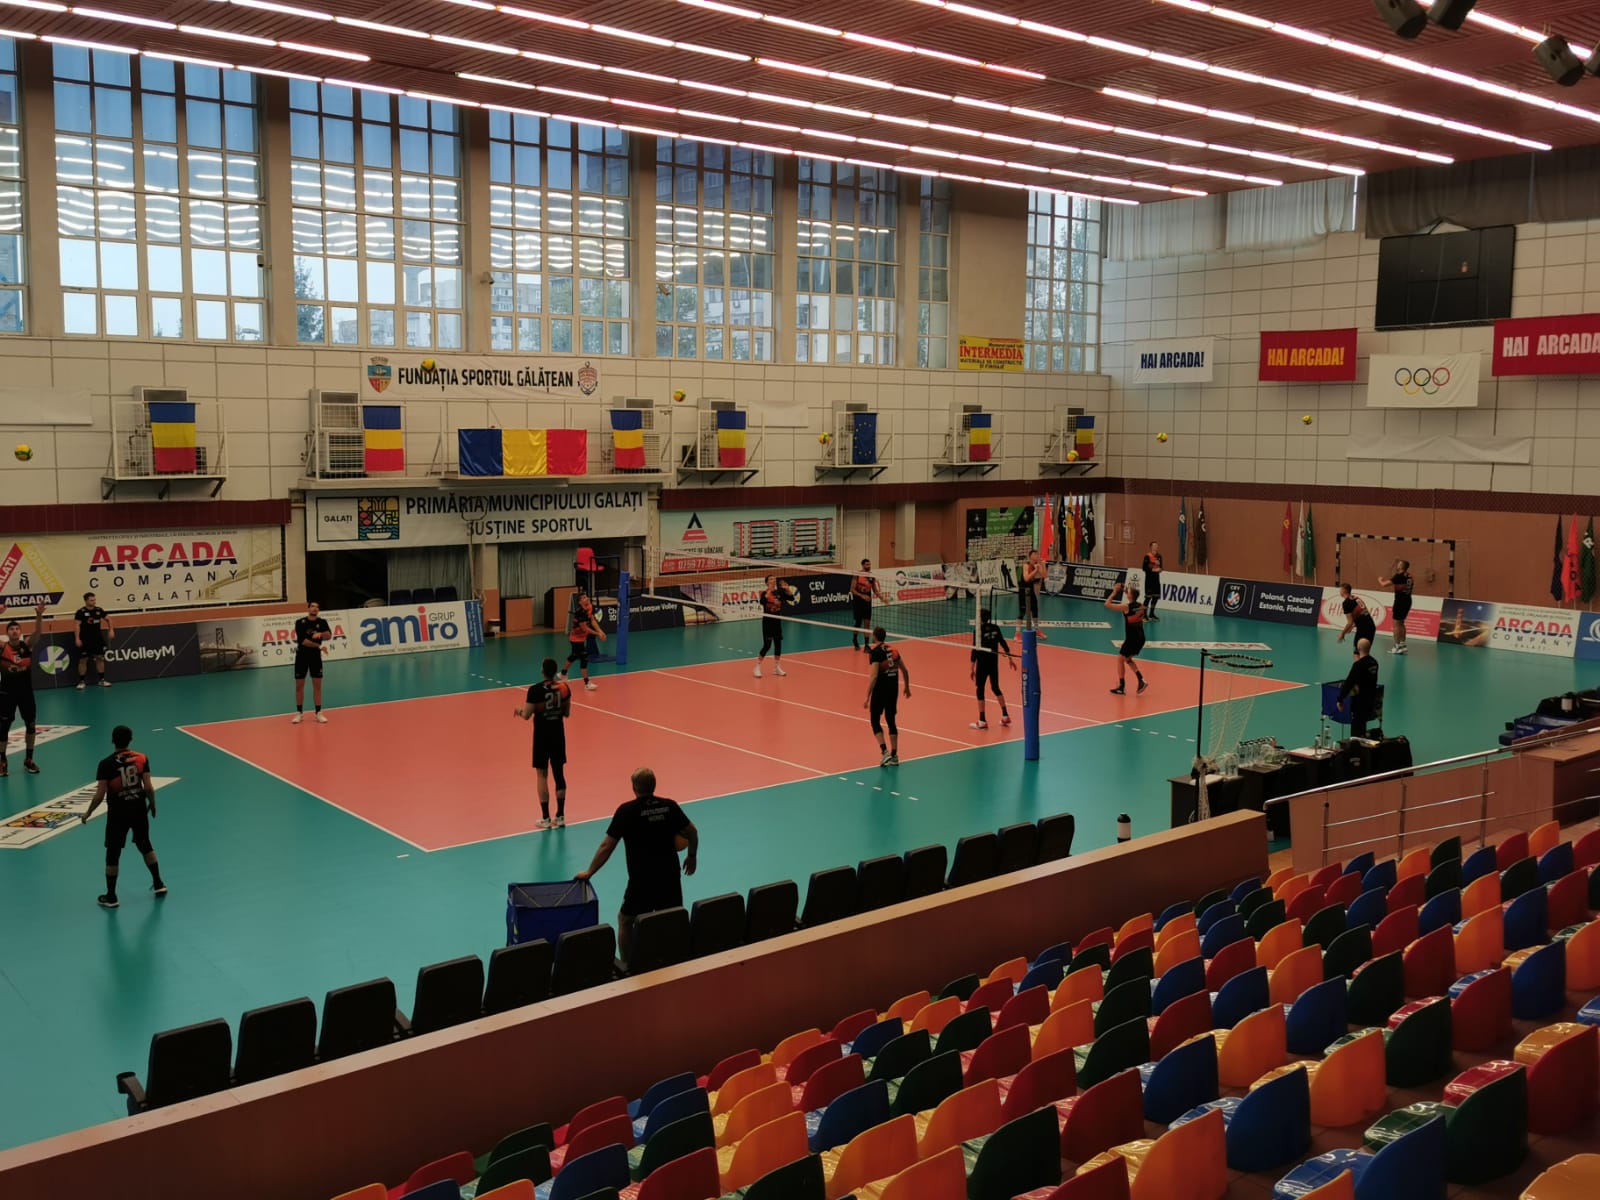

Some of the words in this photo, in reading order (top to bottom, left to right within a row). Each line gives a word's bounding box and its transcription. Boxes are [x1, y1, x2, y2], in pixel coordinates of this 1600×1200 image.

[960, 345, 1024, 360] INTERMEDIA
[1503, 336, 1529, 357] HAI
[1140, 352, 1159, 369] HAI
[1160, 351, 1205, 368] ARCADA!
[1267, 348, 1288, 366] HAI
[1290, 347, 1344, 366] ARCADA!
[398, 367, 459, 391] FUNDAȚIA
[461, 368, 514, 387] SPORTUL
[517, 366, 573, 392] GĂLĂȚEAN
[406, 492, 485, 514] PRIMĂRIA
[488, 493, 592, 512] MUNICIPIULUI
[594, 491, 643, 514] GALAȚI
[466, 520, 525, 538] SUSȚINE
[532, 517, 592, 533] SPORTUL
[89, 540, 238, 572] ARCADA
[89, 570, 239, 589] COMPANY
[809, 581, 825, 591] CEV
[5, 594, 52, 606] ARCADA
[1200, 594, 1214, 607] S.A.
[1259, 602, 1284, 611] Estonia,
[1286, 604, 1313, 614] Finland
[1260, 592, 1286, 602] Poland,
[1287, 594, 1315, 605] Czechia
[360, 605, 458, 647] amiro
[429, 612, 456, 622] GRUP
[1494, 616, 1573, 638] ARCADA
[1492, 632, 1572, 647] COMPANY
[104, 645, 176, 663] CLVolleyM
[544, 691, 561, 710] 21
[117, 765, 139, 788] 18
